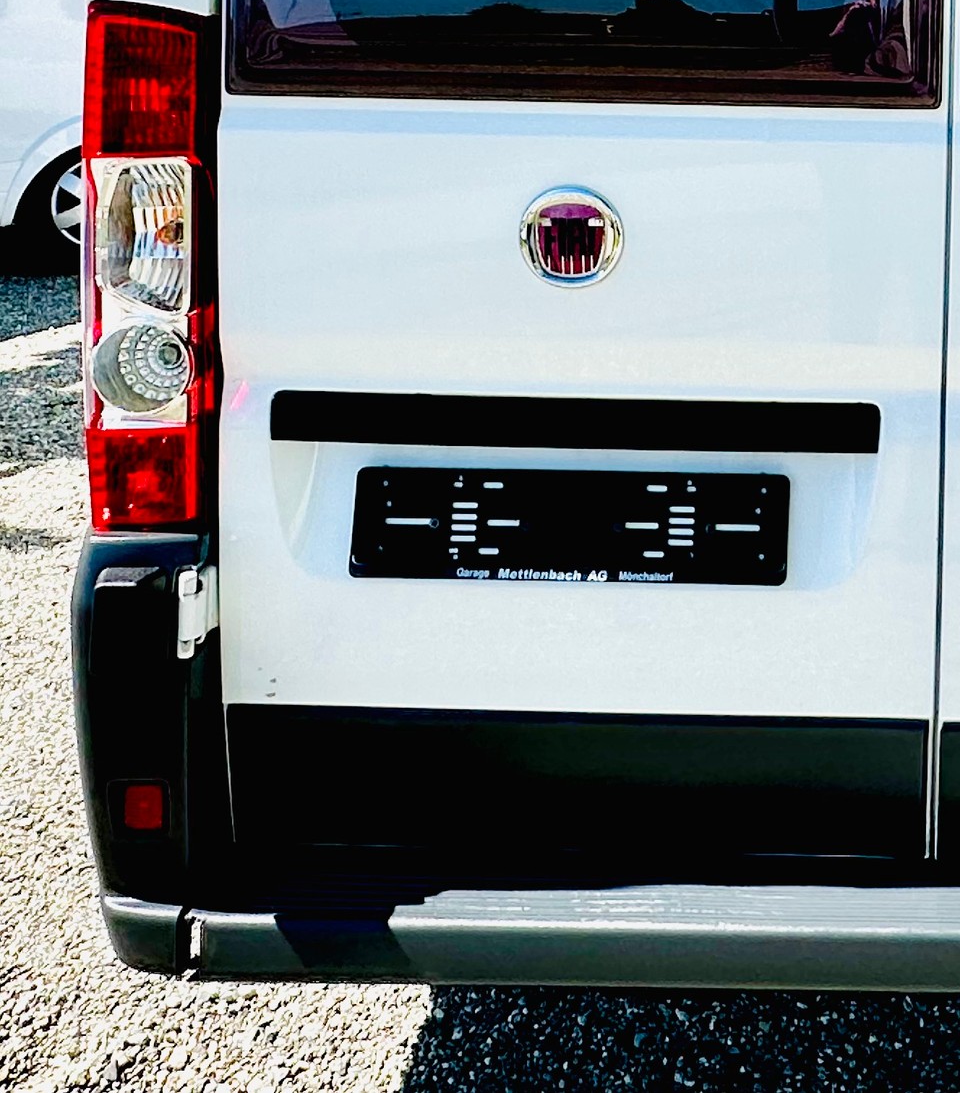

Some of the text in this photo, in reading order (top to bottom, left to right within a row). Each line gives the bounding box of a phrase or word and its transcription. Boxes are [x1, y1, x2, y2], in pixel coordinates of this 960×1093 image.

[456, 567, 490, 579] Garage
[498, 567, 582, 582] Mettlenbach
[587, 569, 608, 582] AG
